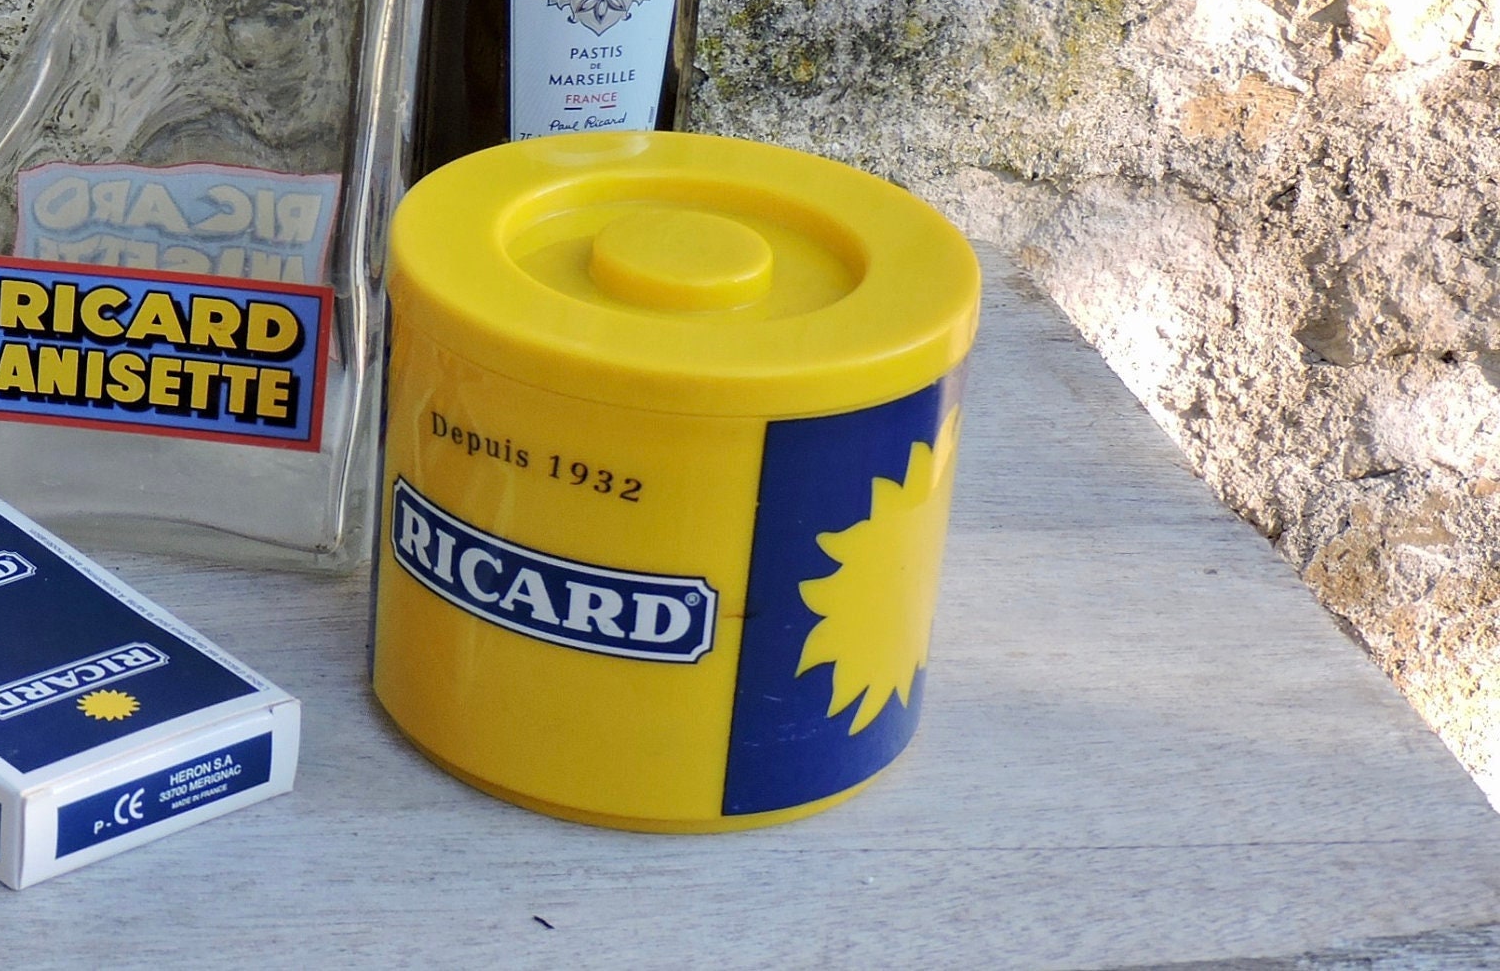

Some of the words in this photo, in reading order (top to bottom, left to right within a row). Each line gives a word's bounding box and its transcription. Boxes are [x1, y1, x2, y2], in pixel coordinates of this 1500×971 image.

[570, 45, 623, 60] PASTIS
[549, 69, 636, 86] MARSEILLE
[565, 92, 617, 104] FRANCE
[549, 119, 579, 131] Paul
[584, 112, 627, 129] Ricard
[431, 411, 529, 469] Depuis
[549, 455, 644, 503] 1932
[169, 760, 211, 786] HERON
[189, 764, 242, 792] MERIGNAC
